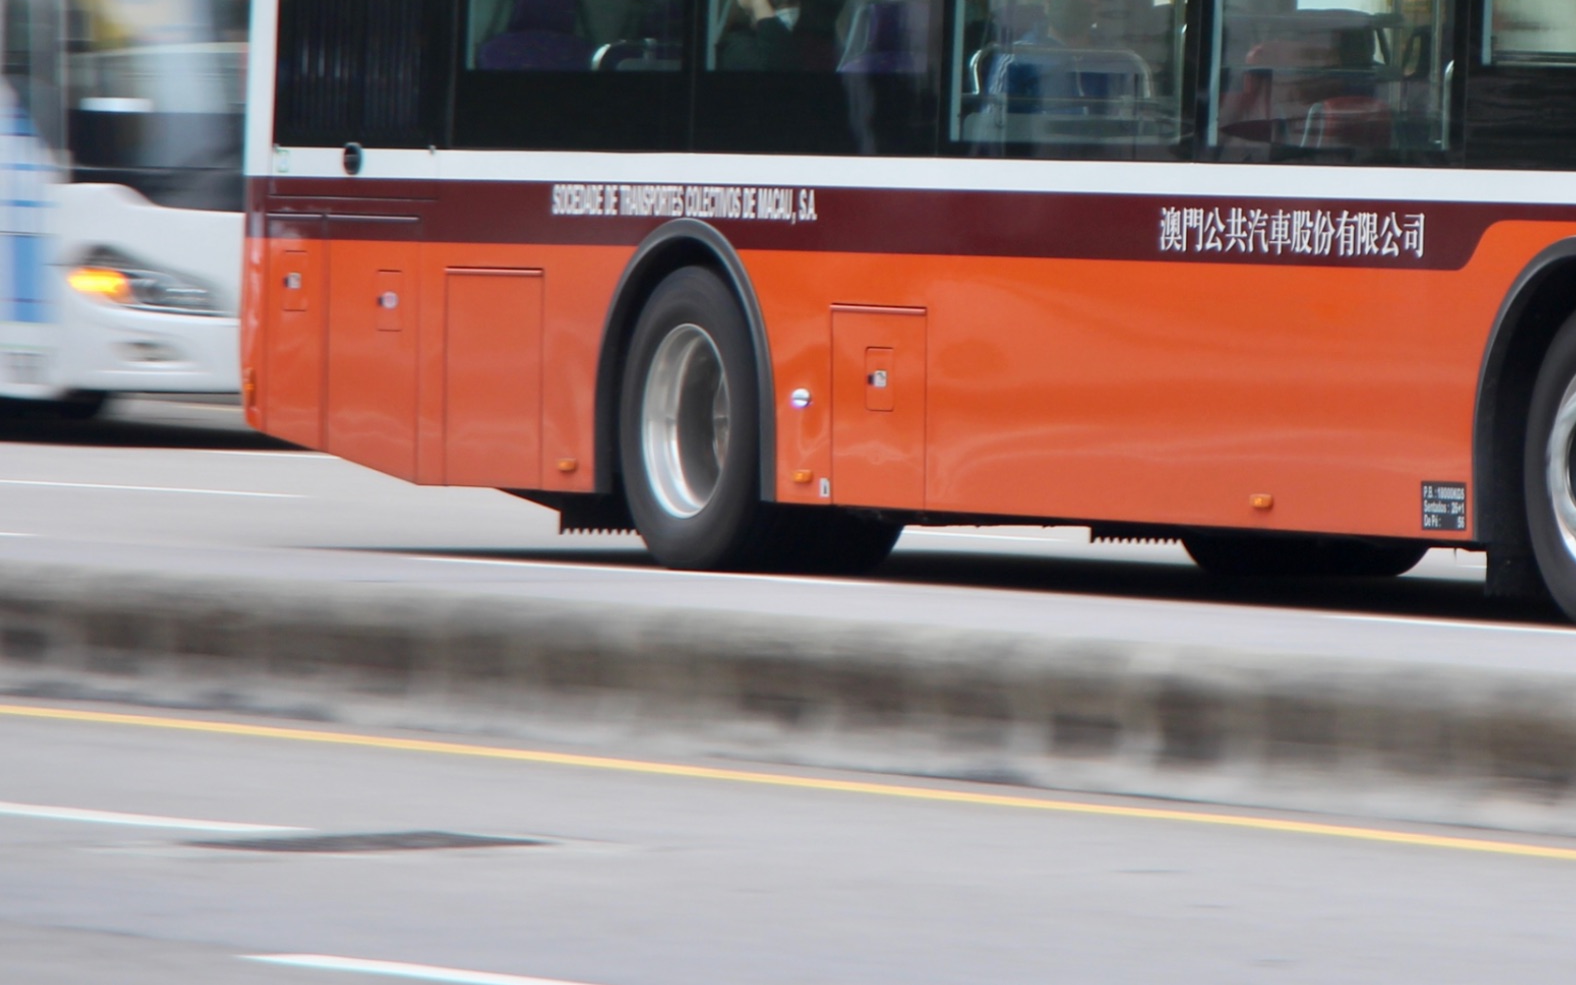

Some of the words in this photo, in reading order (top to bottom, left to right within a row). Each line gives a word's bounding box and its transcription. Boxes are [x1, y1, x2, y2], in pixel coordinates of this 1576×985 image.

[552, 184, 604, 215] SOCIEDADE
[604, 184, 618, 216] DE
[619, 185, 685, 217] TRANSPORTES
[685, 186, 741, 218] COLECTIVOS
[742, 187, 756, 219] DE
[798, 189, 818, 221] S.A.
[1160, 206, 1425, 259] 澳門公共汽車股份有限公司
